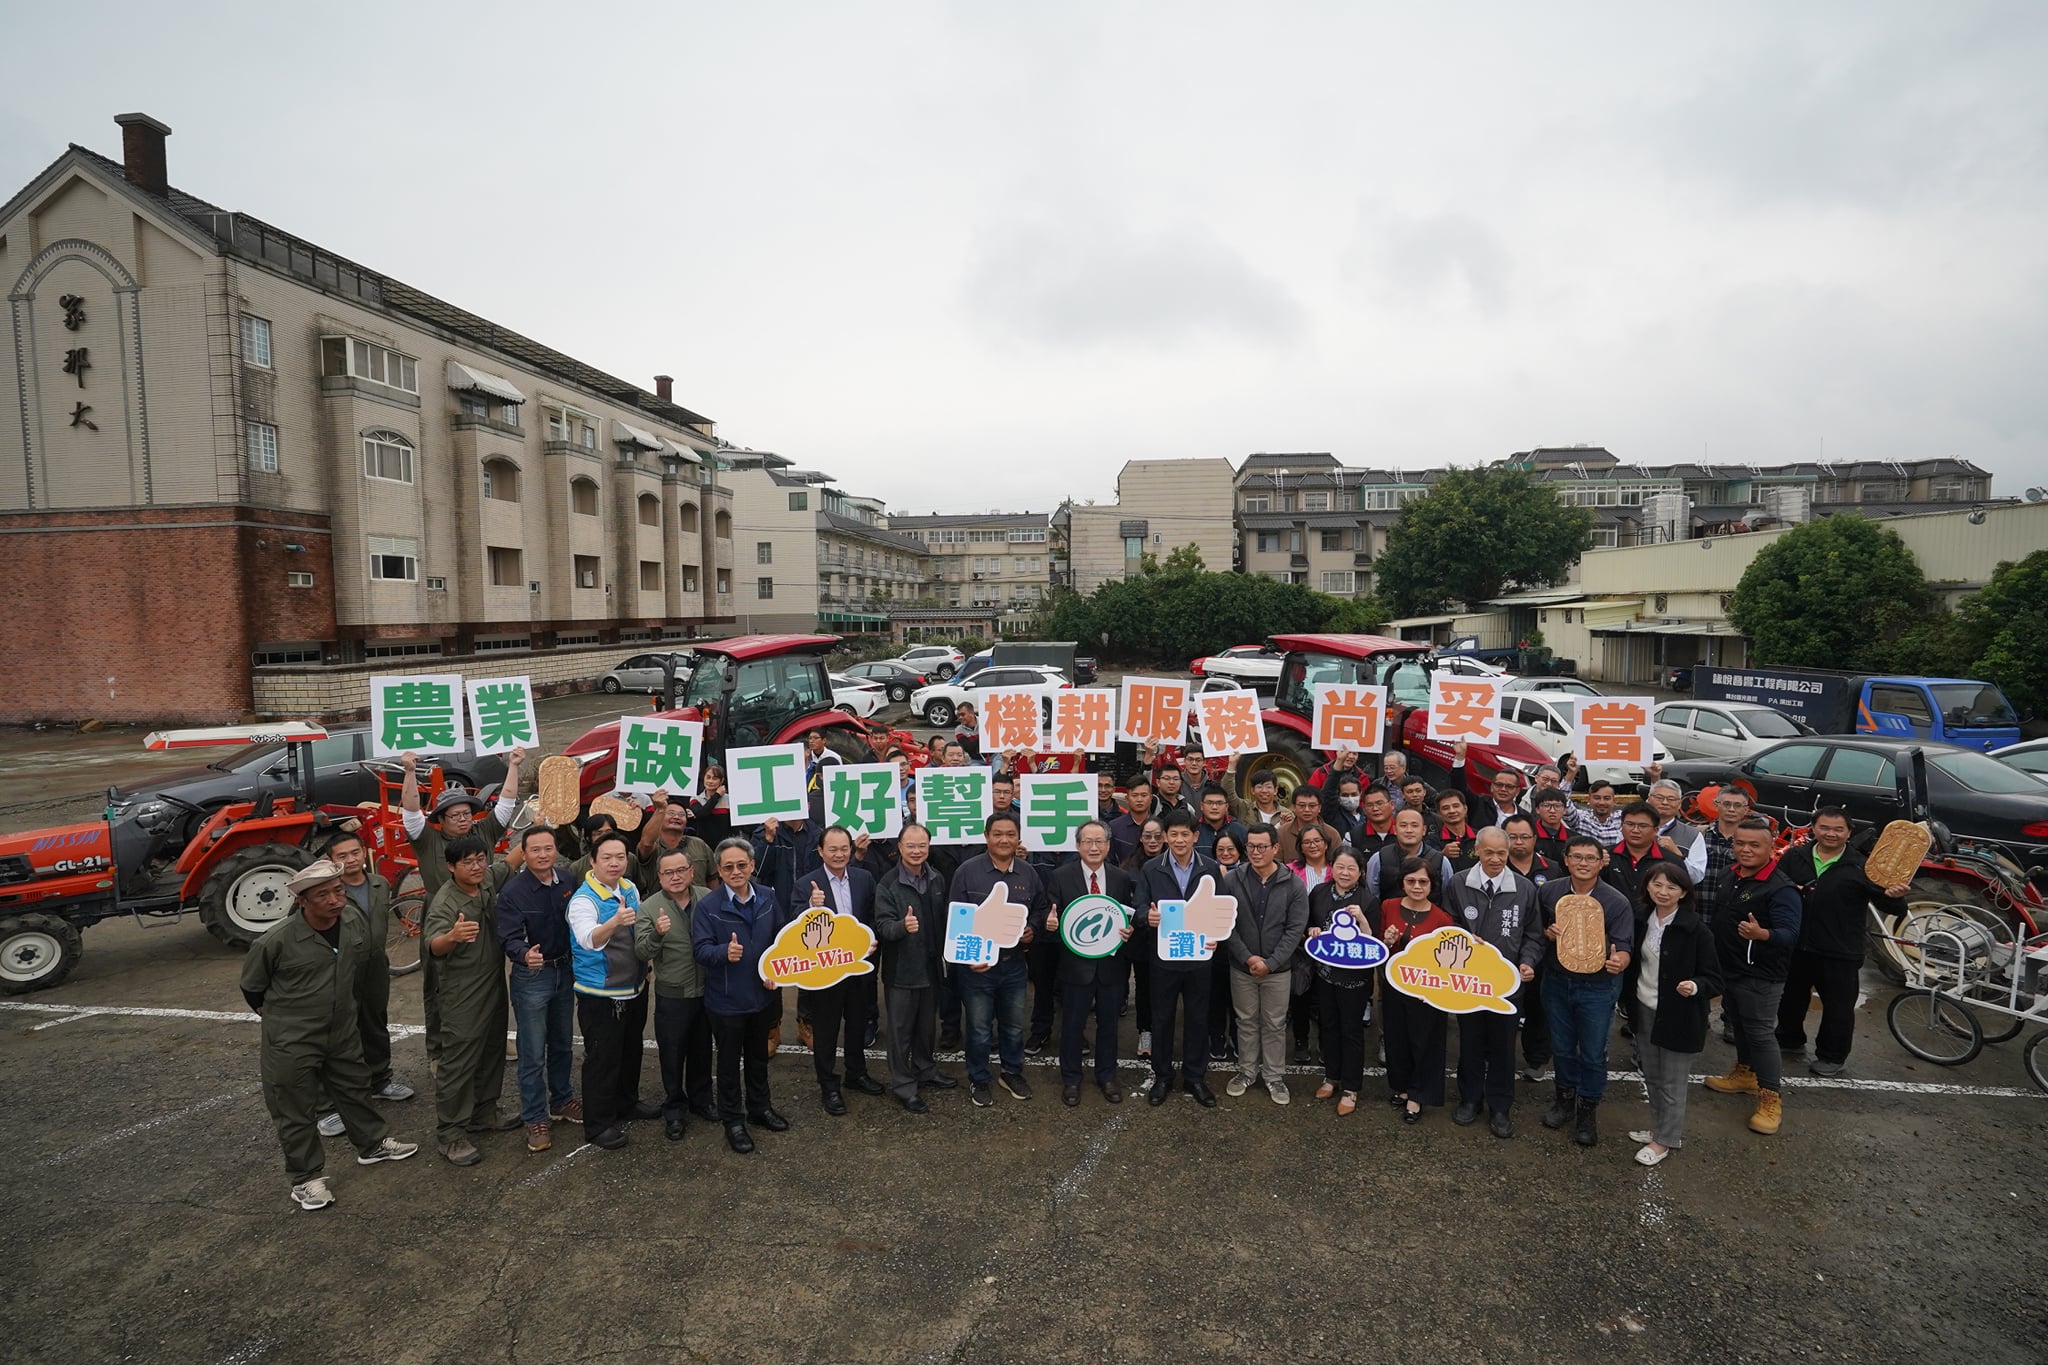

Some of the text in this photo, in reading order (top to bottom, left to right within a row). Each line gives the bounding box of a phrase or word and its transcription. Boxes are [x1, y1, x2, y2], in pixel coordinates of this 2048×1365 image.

[382, 683, 455, 749] 農
[476, 684, 530, 747] 業
[986, 694, 1037, 747] 機
[1058, 695, 1108, 746] 耕
[1126, 685, 1183, 739] 服
[1204, 697, 1258, 749] 務
[1320, 691, 1376, 746] 尚
[1436, 682, 1493, 736] 妥
[1582, 704, 1645, 760] 當
[249, 734, 287, 743] Kubota
[625, 725, 692, 788] 缺
[738, 755, 800, 815] 工
[831, 772, 894, 833] 好
[923, 774, 985, 838] 幫
[32, 830, 102, 851] NISSIN
[1028, 782, 1089, 845] 手
[54, 855, 102, 872] GL-21
[772, 949, 854, 976] Win-Win
[1313, 940, 1381, 960] 人力發展
[1400, 966, 1492, 996] Win-Win
